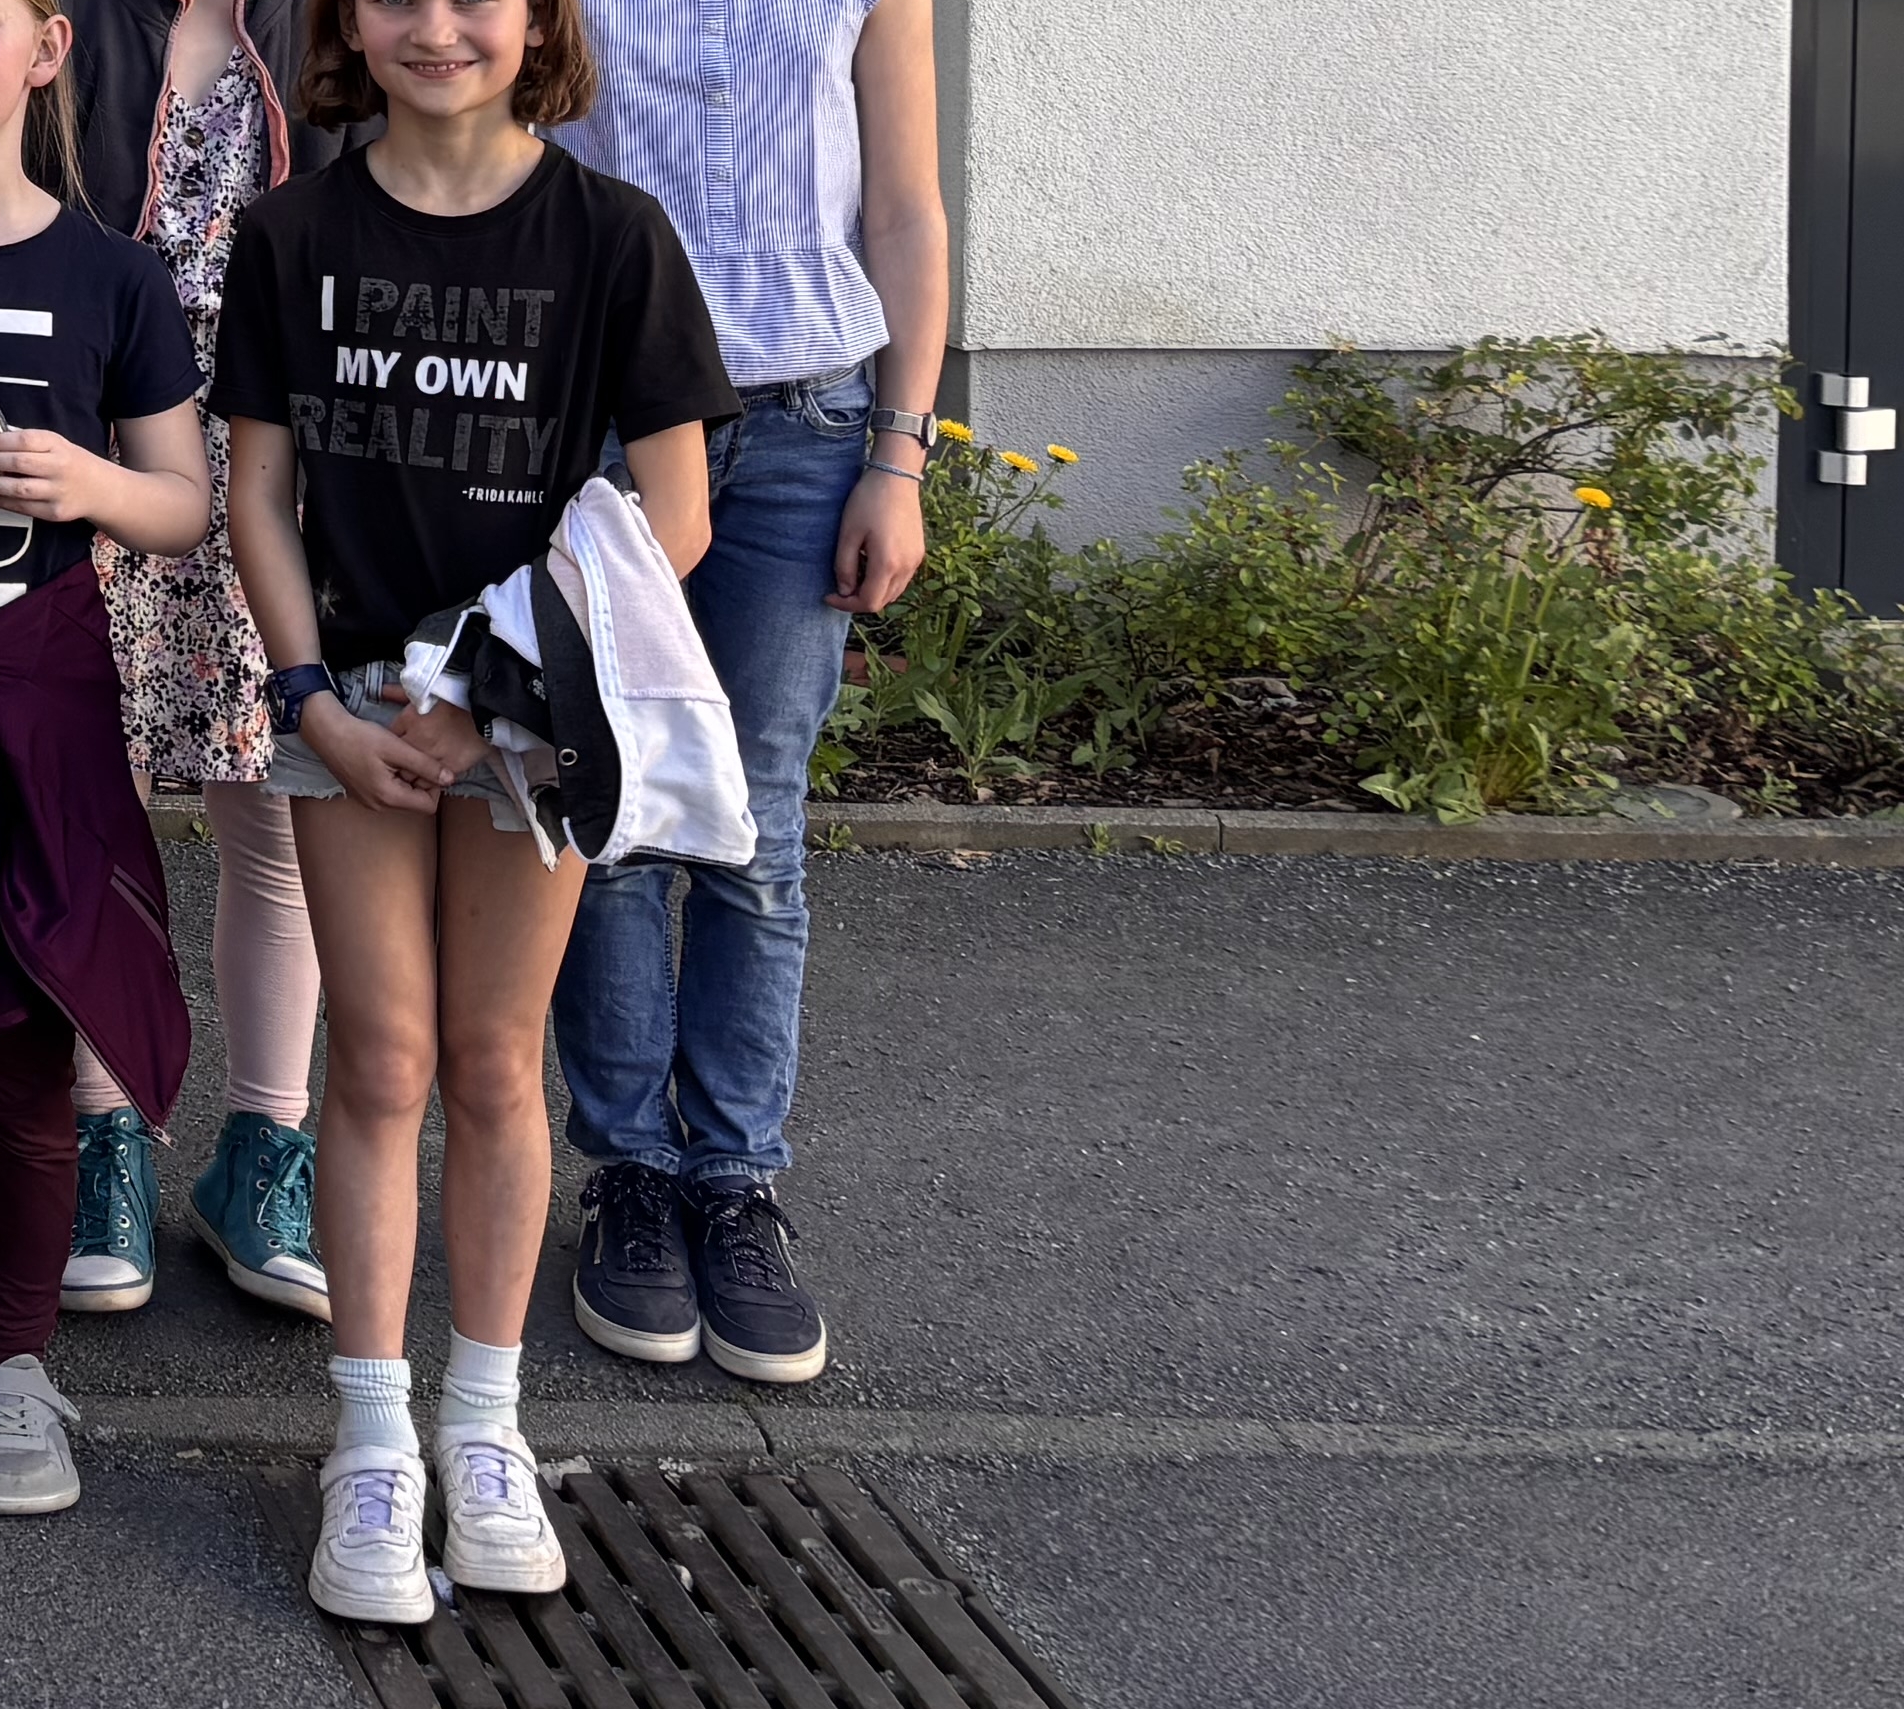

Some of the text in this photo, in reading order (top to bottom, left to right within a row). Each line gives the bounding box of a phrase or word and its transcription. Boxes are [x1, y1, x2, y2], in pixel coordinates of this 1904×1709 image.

[320, 275, 556, 348] I PAINT
[335, 346, 529, 402] MY OWN
[288, 393, 559, 476] REALITY
